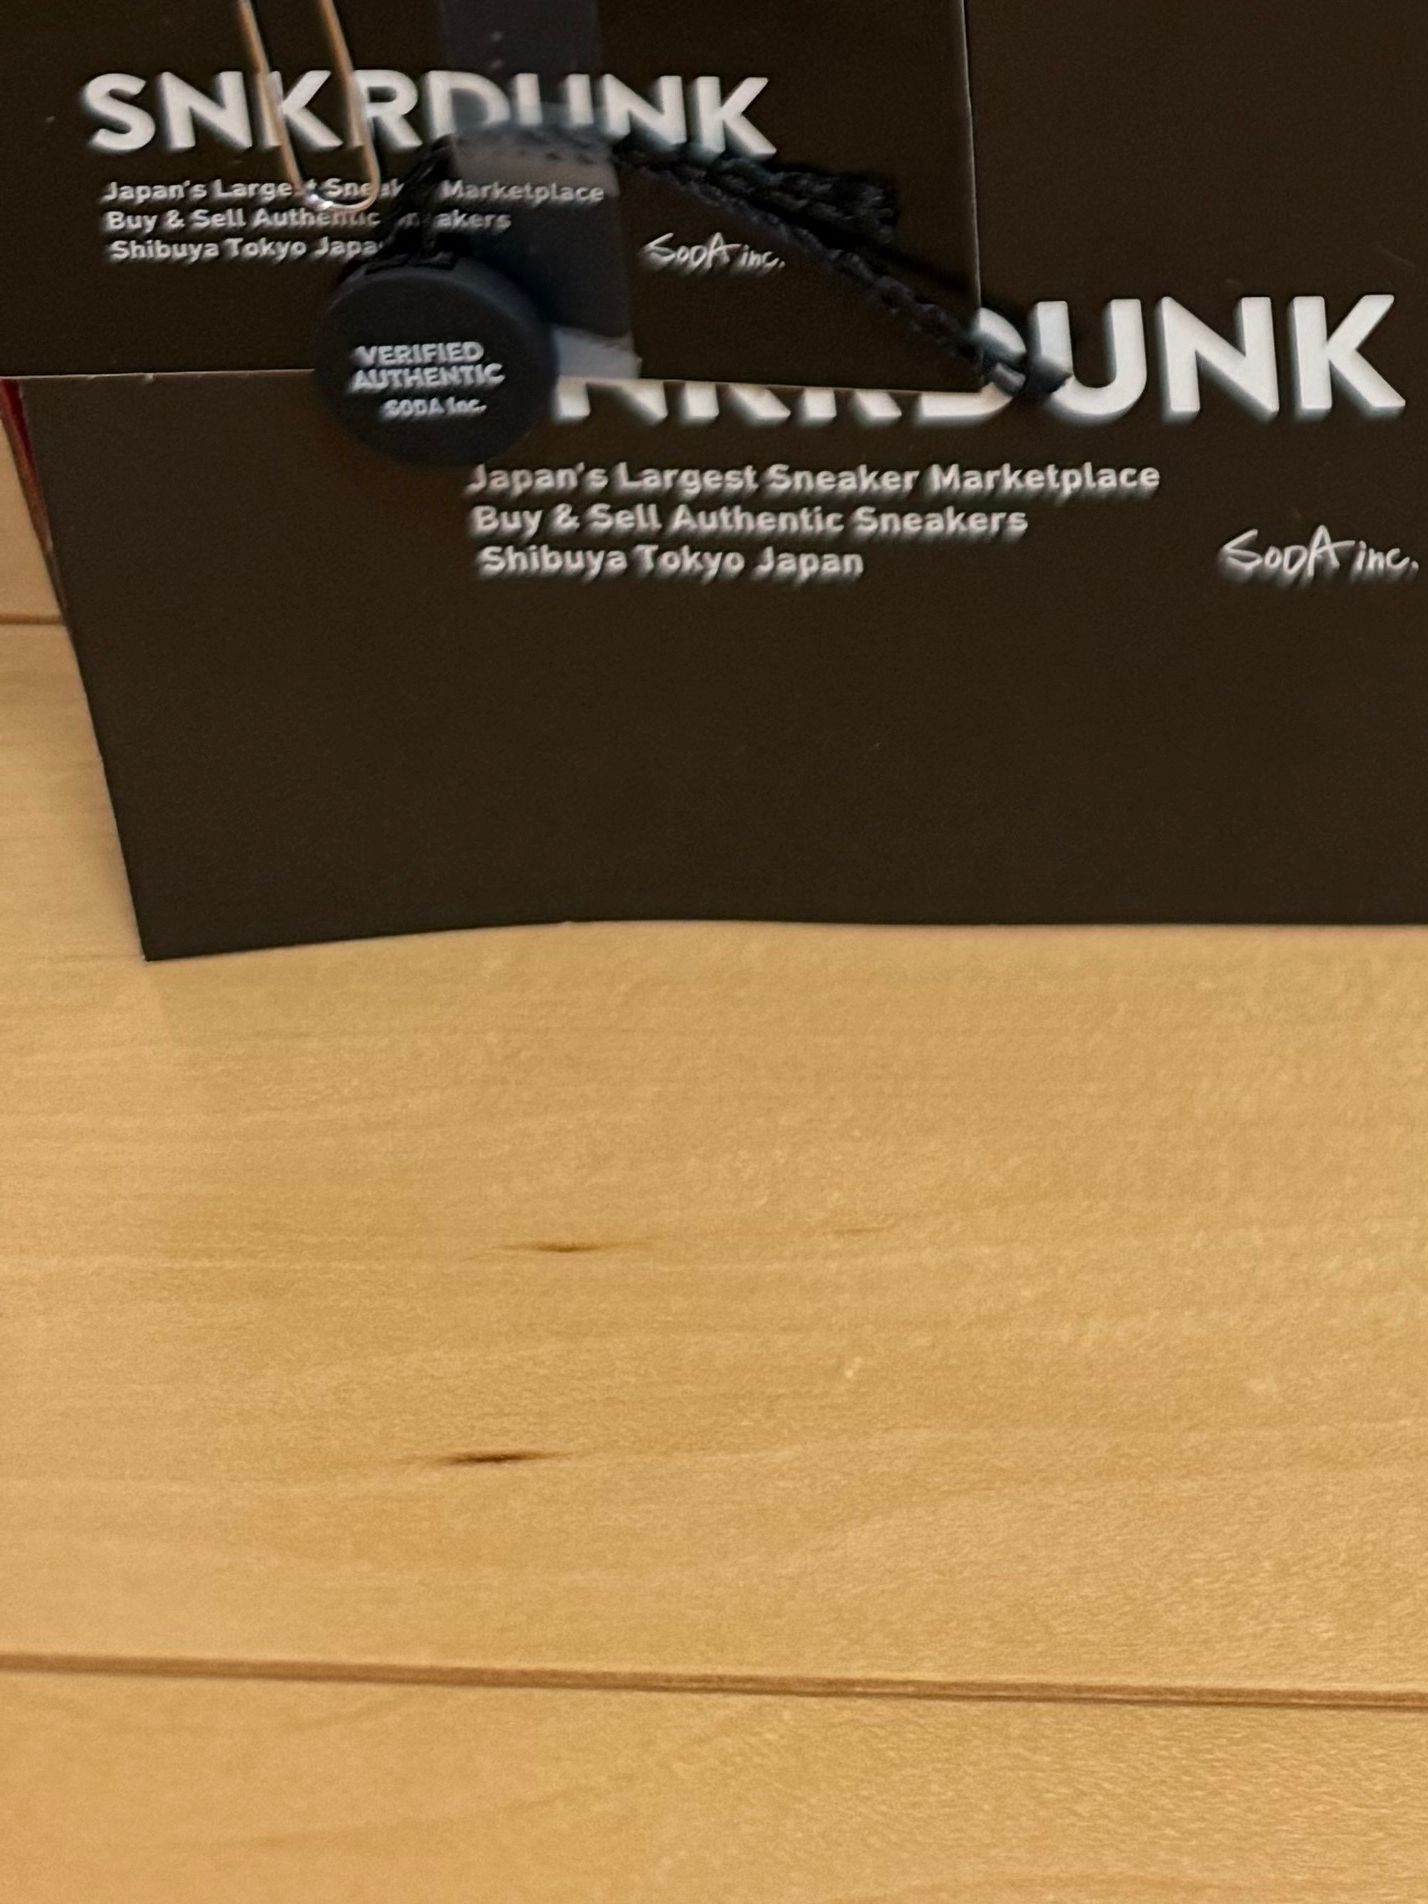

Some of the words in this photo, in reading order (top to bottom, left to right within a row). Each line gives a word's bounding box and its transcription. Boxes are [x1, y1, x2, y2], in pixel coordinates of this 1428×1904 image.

[103, 179, 207, 203] Japan's
[214, 178, 317, 203] Larget
[441, 179, 605, 206] Marketplace
[105, 210, 157, 233] Buy
[165, 209, 186, 230] &
[191, 208, 246, 228] Sell
[252, 208, 382, 229] Authentic
[110, 238, 220, 263] Shibuya
[222, 237, 307, 263] Tokyo
[316, 237, 382, 262] Japa
[353, 341, 485, 366] VERIFIED
[350, 363, 506, 391] AUTHENTIC
[382, 397, 445, 419] SODA
[466, 462, 609, 496] Japan's
[611, 461, 759, 496] Largest
[761, 463, 921, 493] Sneaker
[928, 462, 1161, 502] Marketplace
[473, 505, 543, 539] Buy
[550, 503, 580, 531] &
[586, 503, 662, 531] Sell
[668, 504, 845, 534] Authentic
[852, 506, 1028, 536] Sneakers
[479, 545, 628, 580] Shibuya
[632, 544, 745, 580] Tokyo
[753, 546, 864, 582] Japan
